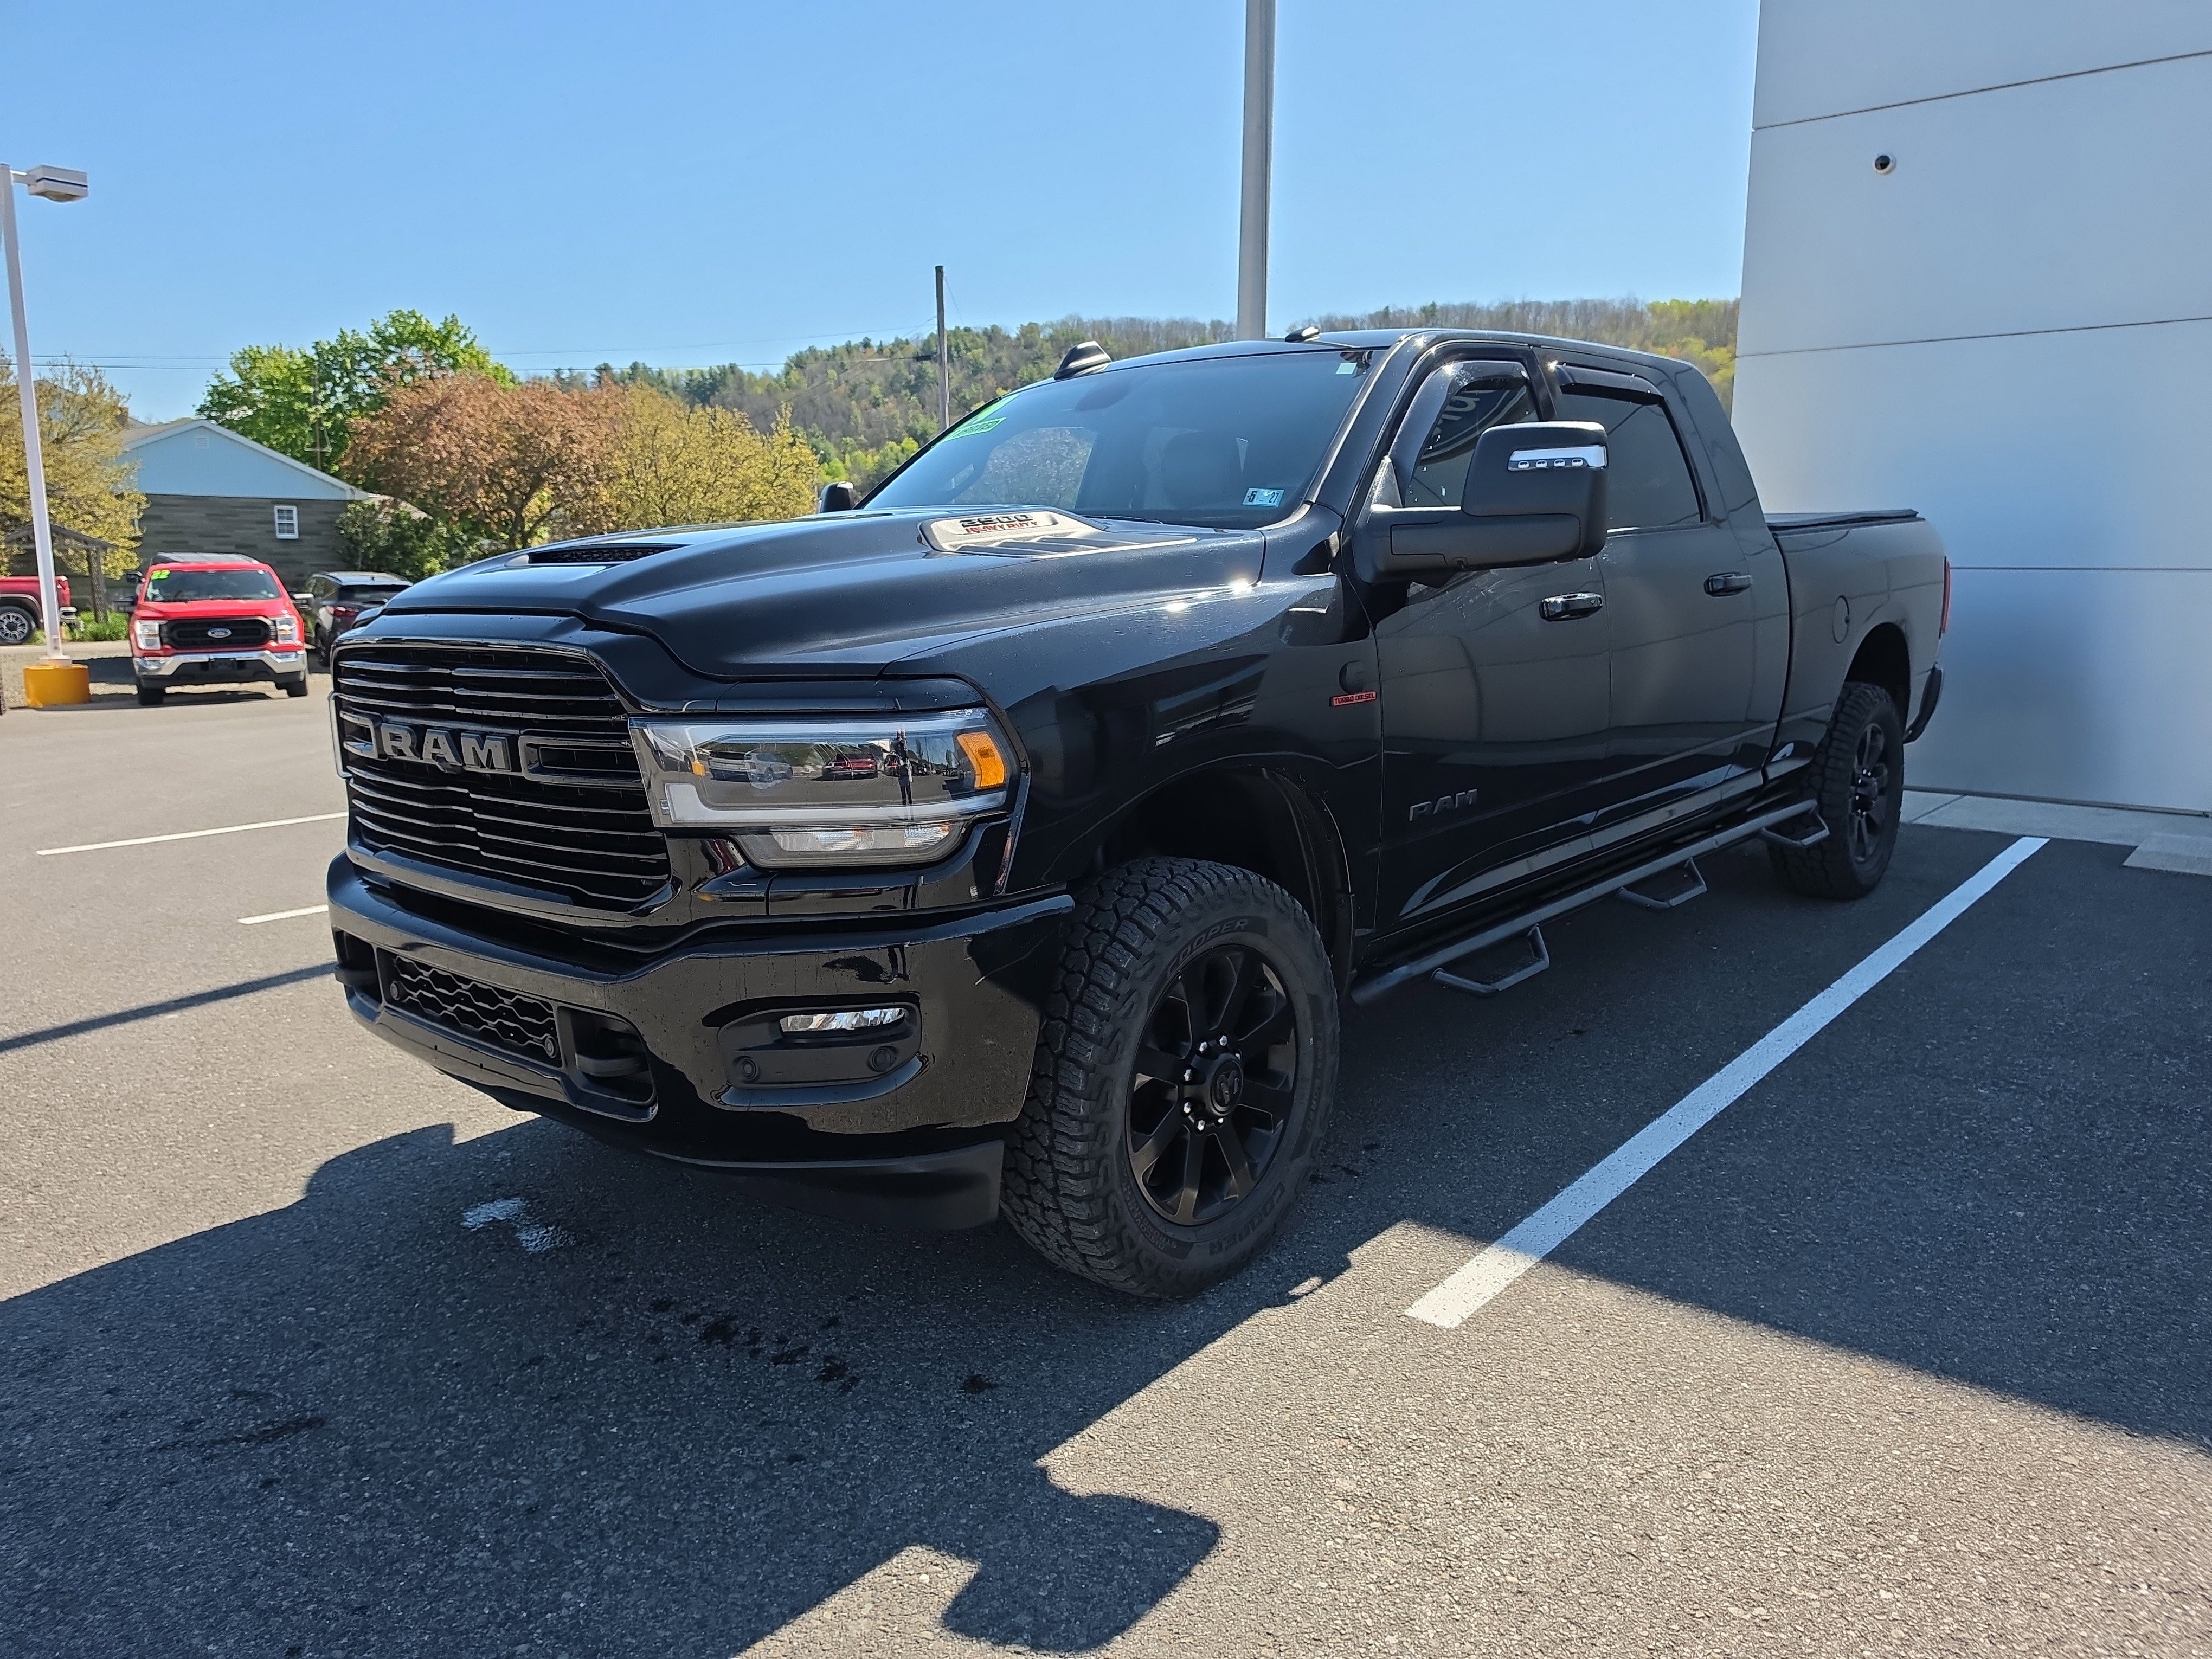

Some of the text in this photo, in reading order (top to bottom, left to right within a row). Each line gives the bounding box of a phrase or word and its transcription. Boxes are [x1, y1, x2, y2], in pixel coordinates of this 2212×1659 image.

[1248, 491, 1279, 503] 5 27
[960, 514, 1034, 528] 2500
[965, 521, 1038, 533] HEAVY DUTY
[1334, 693, 1375, 704] TURBO DIESEL
[381, 722, 513, 771] RAM
[1409, 789, 1477, 821] RAM
[1167, 918, 1249, 978] COOPER
[1209, 1181, 1285, 1255] COOPER
